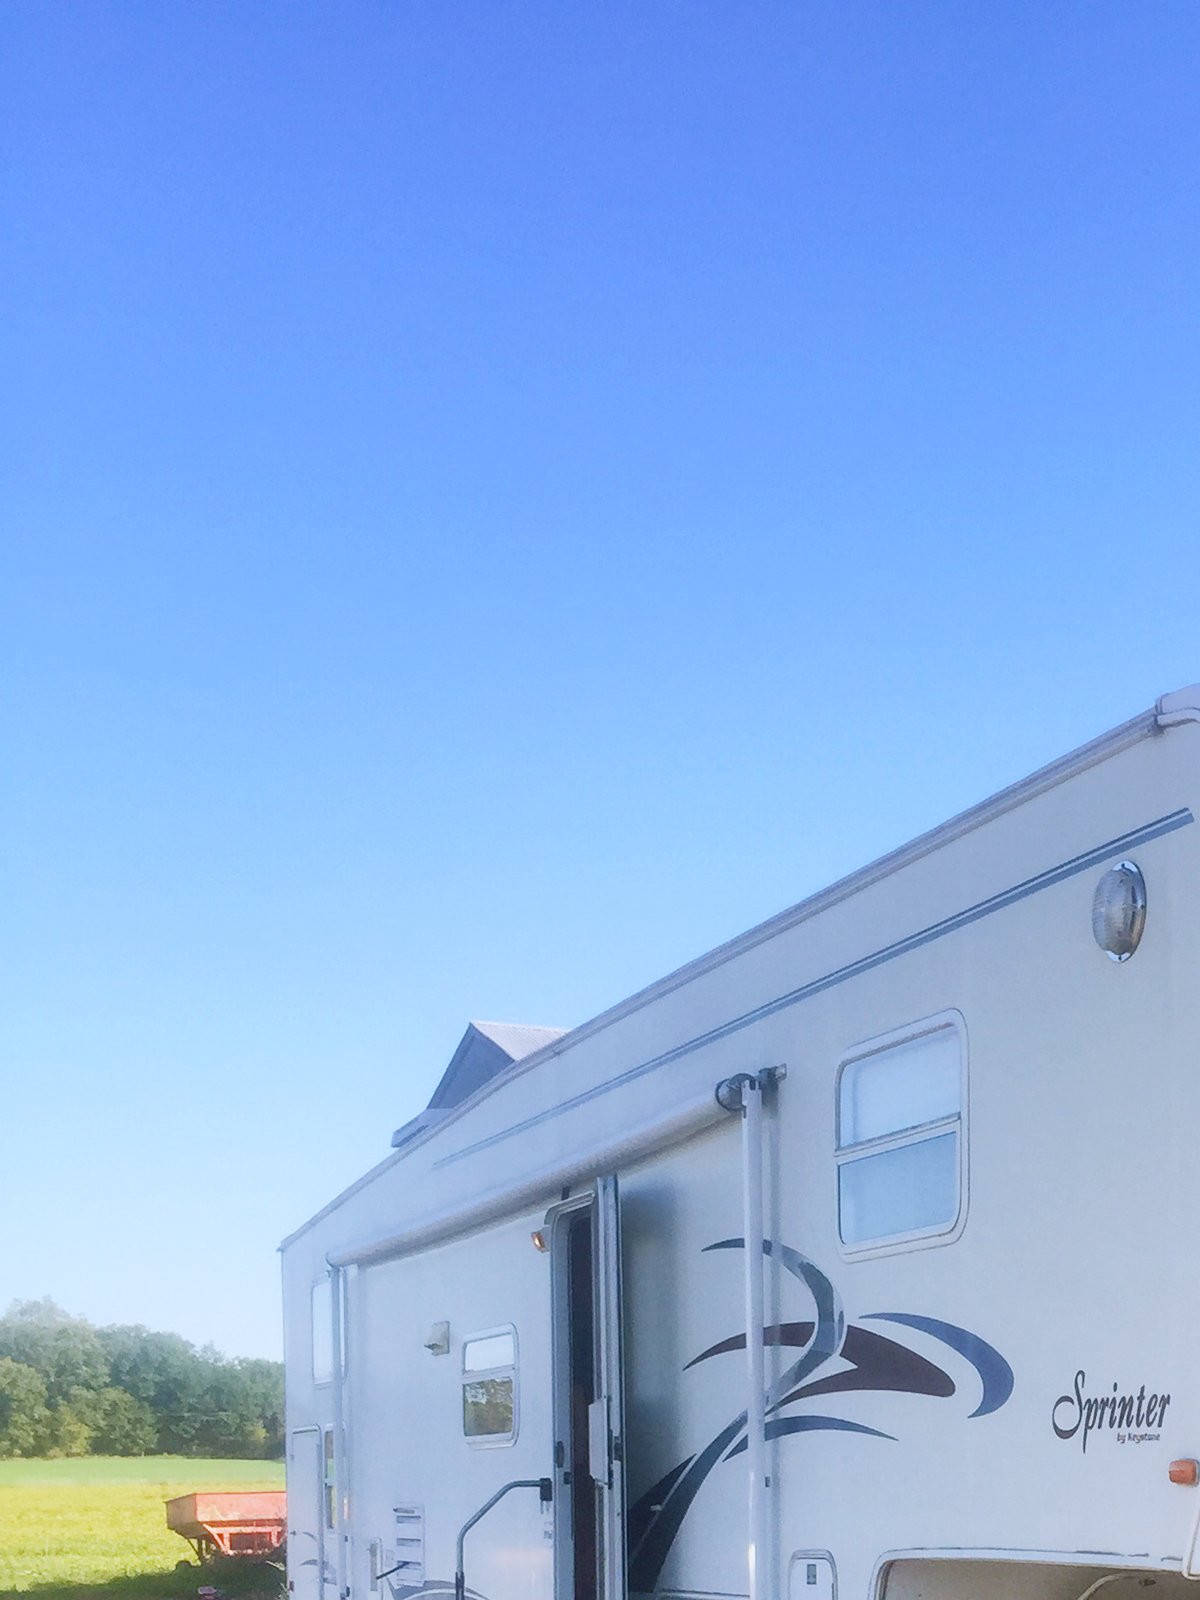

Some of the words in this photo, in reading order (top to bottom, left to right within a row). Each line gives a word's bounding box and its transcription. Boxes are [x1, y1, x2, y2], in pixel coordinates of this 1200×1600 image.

[1052, 1369, 1171, 1454] Sprinter
[1117, 1432, 1126, 1444] by
[1128, 1432, 1161, 1443] Keystone
